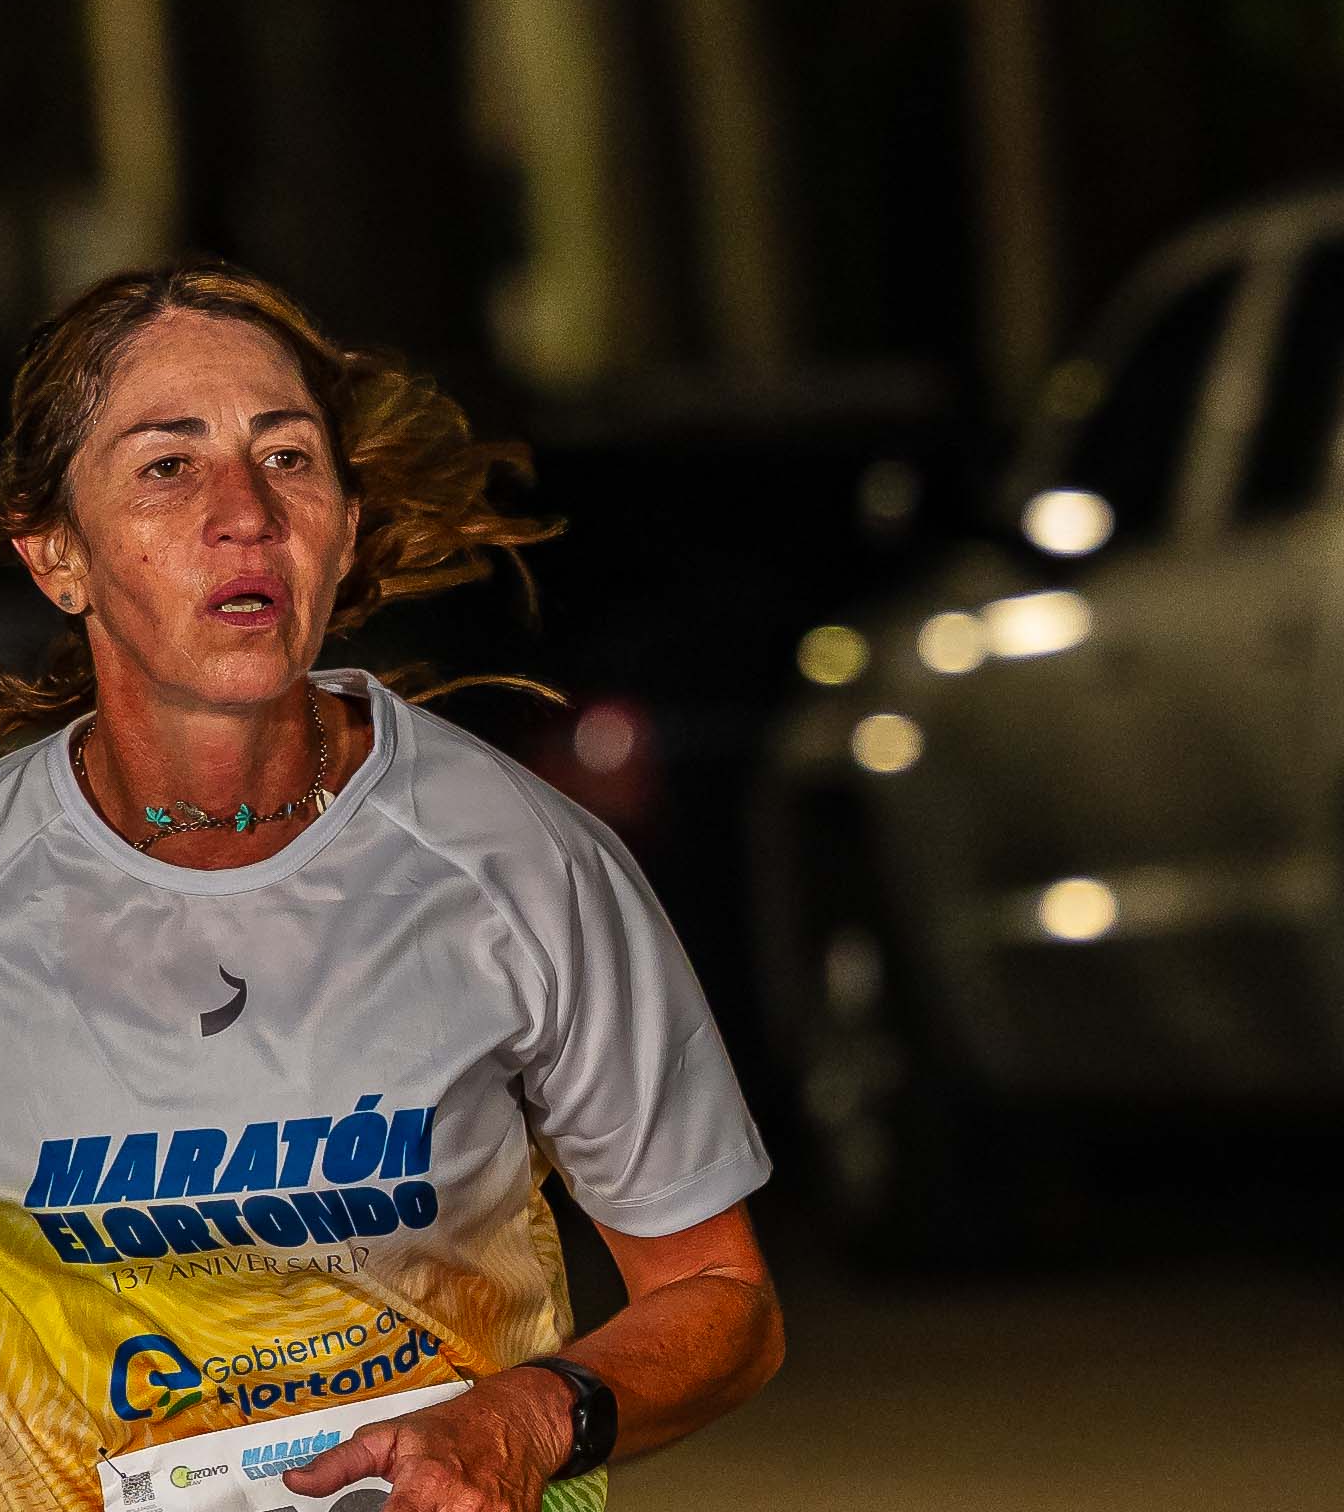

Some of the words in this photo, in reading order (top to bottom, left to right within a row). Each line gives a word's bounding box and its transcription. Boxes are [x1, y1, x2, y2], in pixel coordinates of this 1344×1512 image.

[24, 1094, 437, 1208] MARATÓN
[32, 1180, 438, 1264] ELORTONDO
[111, 1265, 155, 1294] 137
[203, 1324, 367, 1384] Gobierno
[376, 1305, 408, 1334] d
[242, 1430, 341, 1467] MARATÓN
